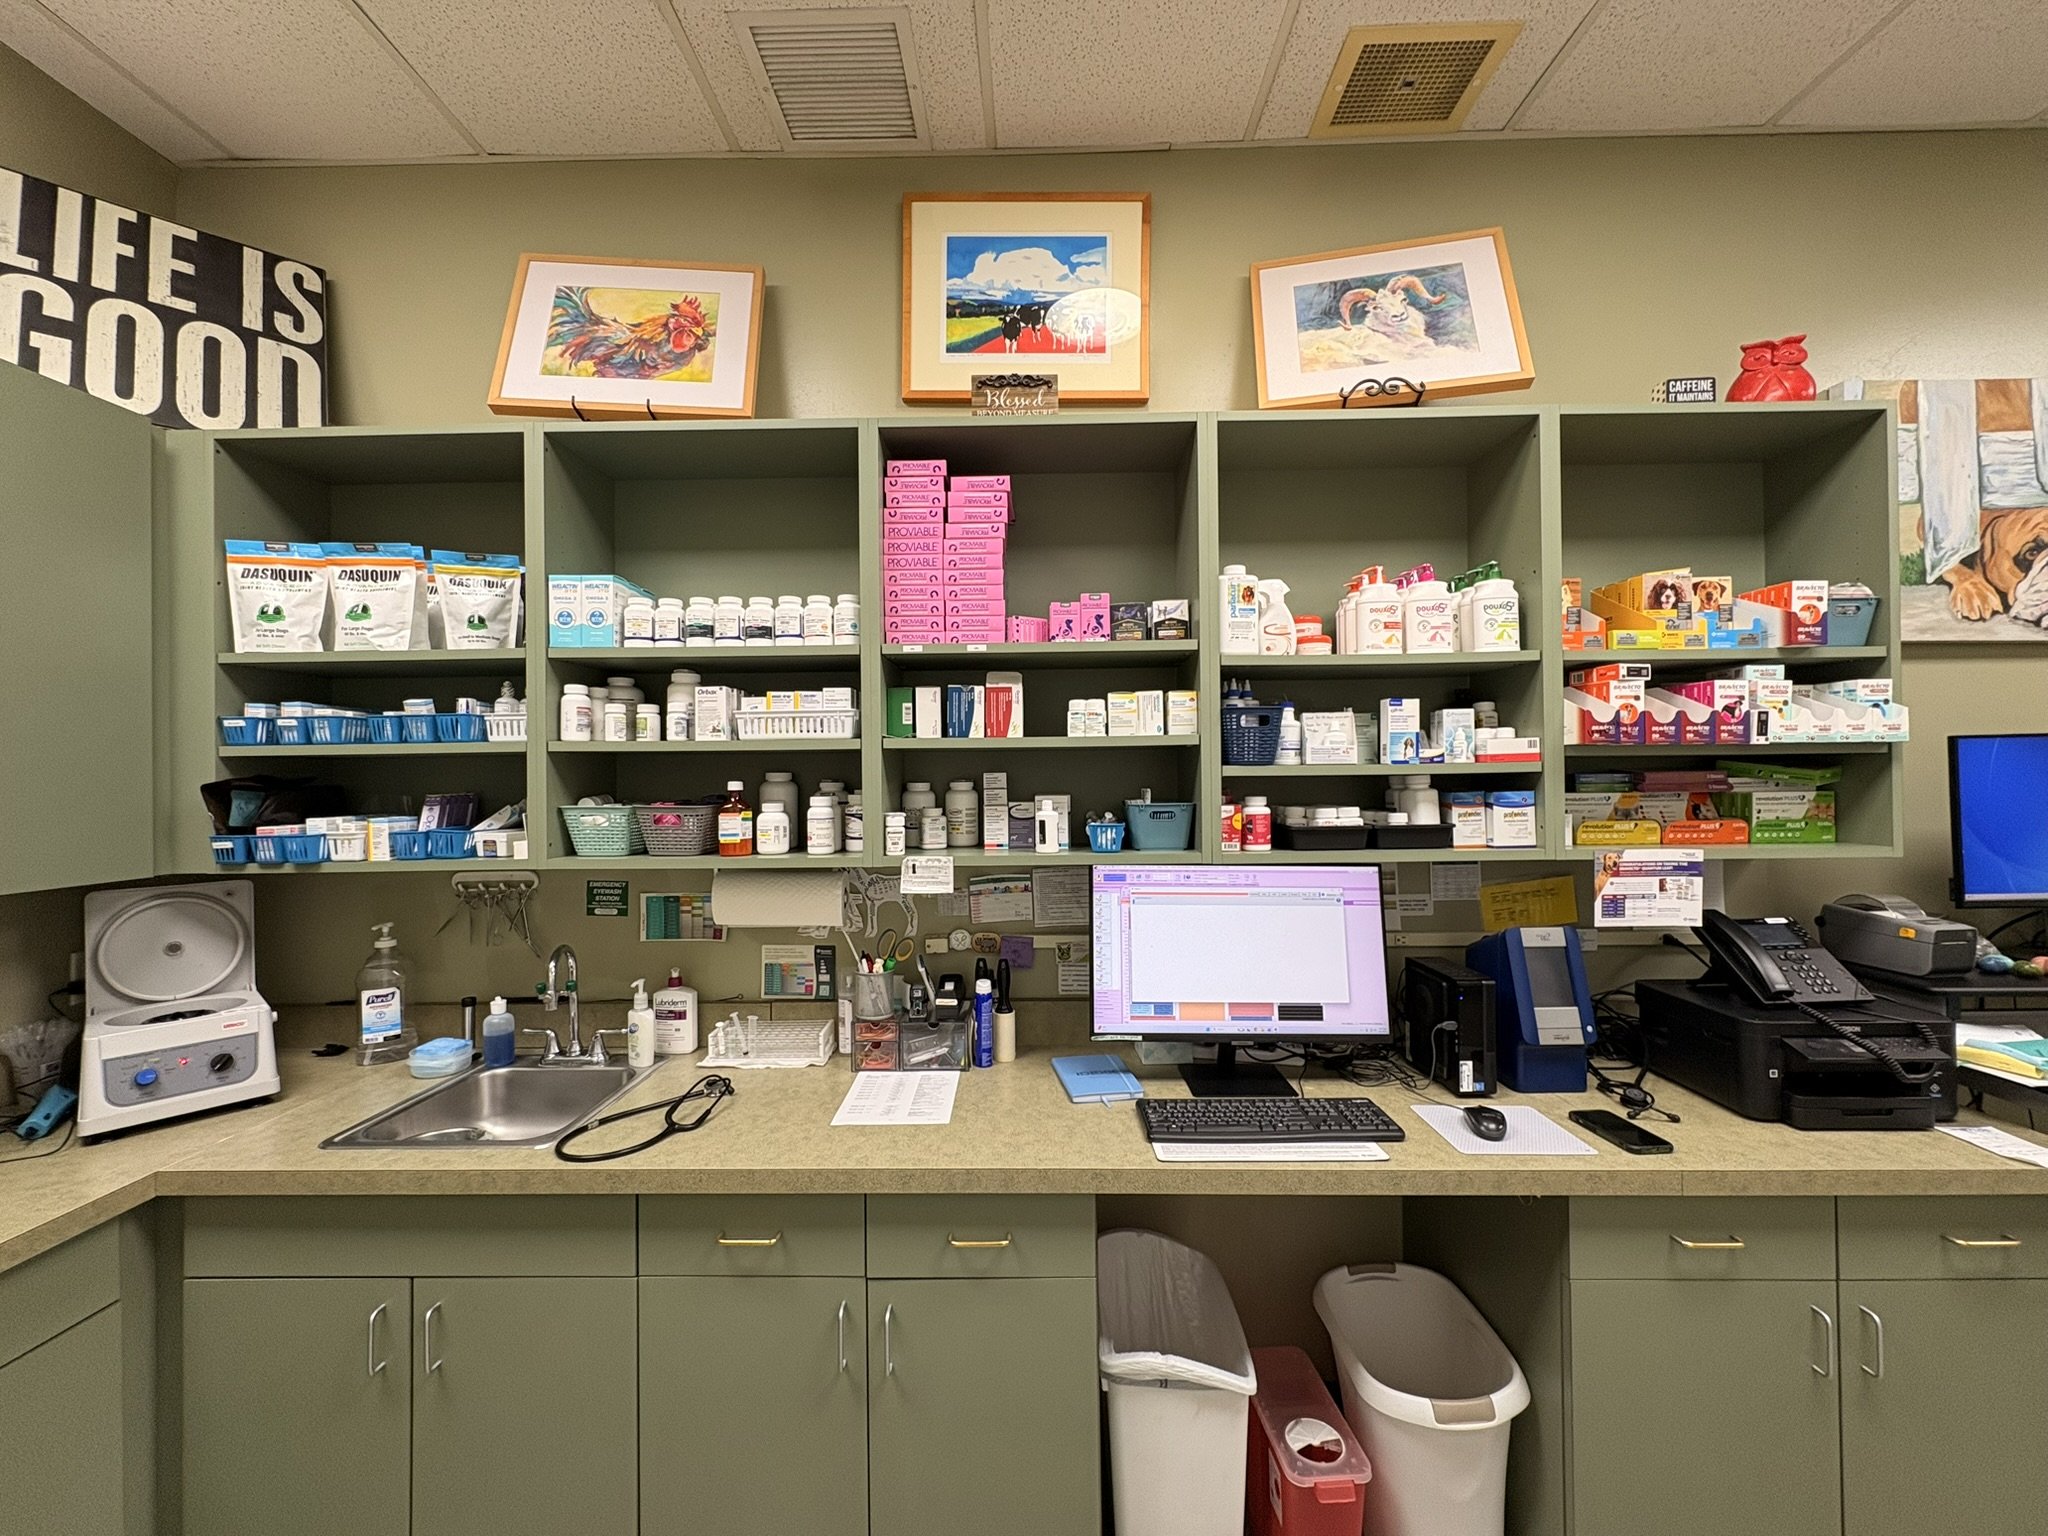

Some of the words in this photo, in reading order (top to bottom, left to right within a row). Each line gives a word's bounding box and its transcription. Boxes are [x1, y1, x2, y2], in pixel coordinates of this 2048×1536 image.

[0, 166, 198, 314] LIFE
[242, 246, 324, 345] IS
[1669, 379, 1714, 393] CAFFEINE
[984, 388, 1046, 410] Blessed
[1669, 393, 1676, 402] IT
[1676, 392, 1714, 402] MAINTAINS
[1014, 408, 1054, 416] MEASURE
[887, 526, 936, 537] PROVIABLE
[887, 541, 936, 552] PROVIABLE
[887, 557, 936, 568] PROVIABLE
[241, 568, 313, 583] DASUQUIN
[338, 569, 401, 583] DASUQUIN
[449, 577, 507, 590] DASUQUIN
[1230, 583, 1238, 618] panacur
